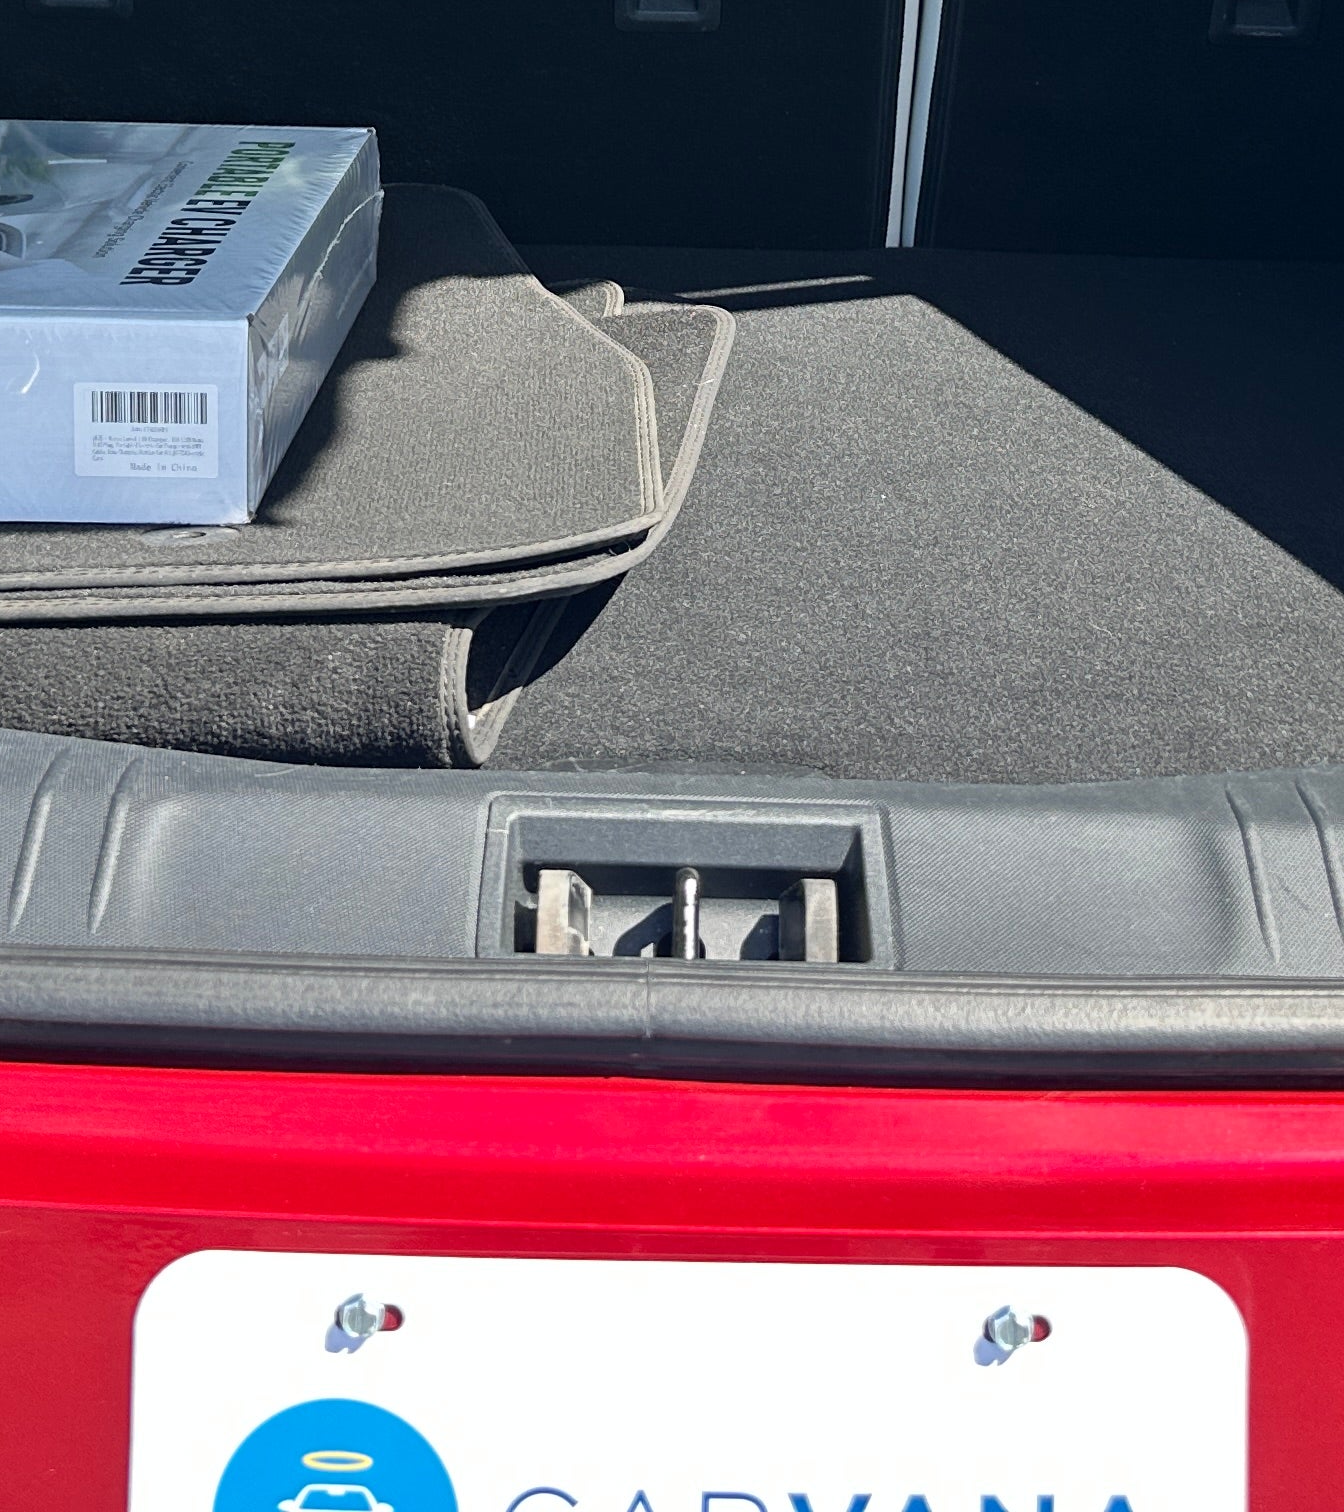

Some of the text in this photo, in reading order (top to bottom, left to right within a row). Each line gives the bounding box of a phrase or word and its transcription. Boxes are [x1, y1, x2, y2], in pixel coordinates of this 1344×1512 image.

[118, 140, 296, 286] PORTABLE EV CHARGER
[107, 215, 145, 237] Charging
[92, 237, 126, 258] Solution
[171, 463, 198, 473] China
